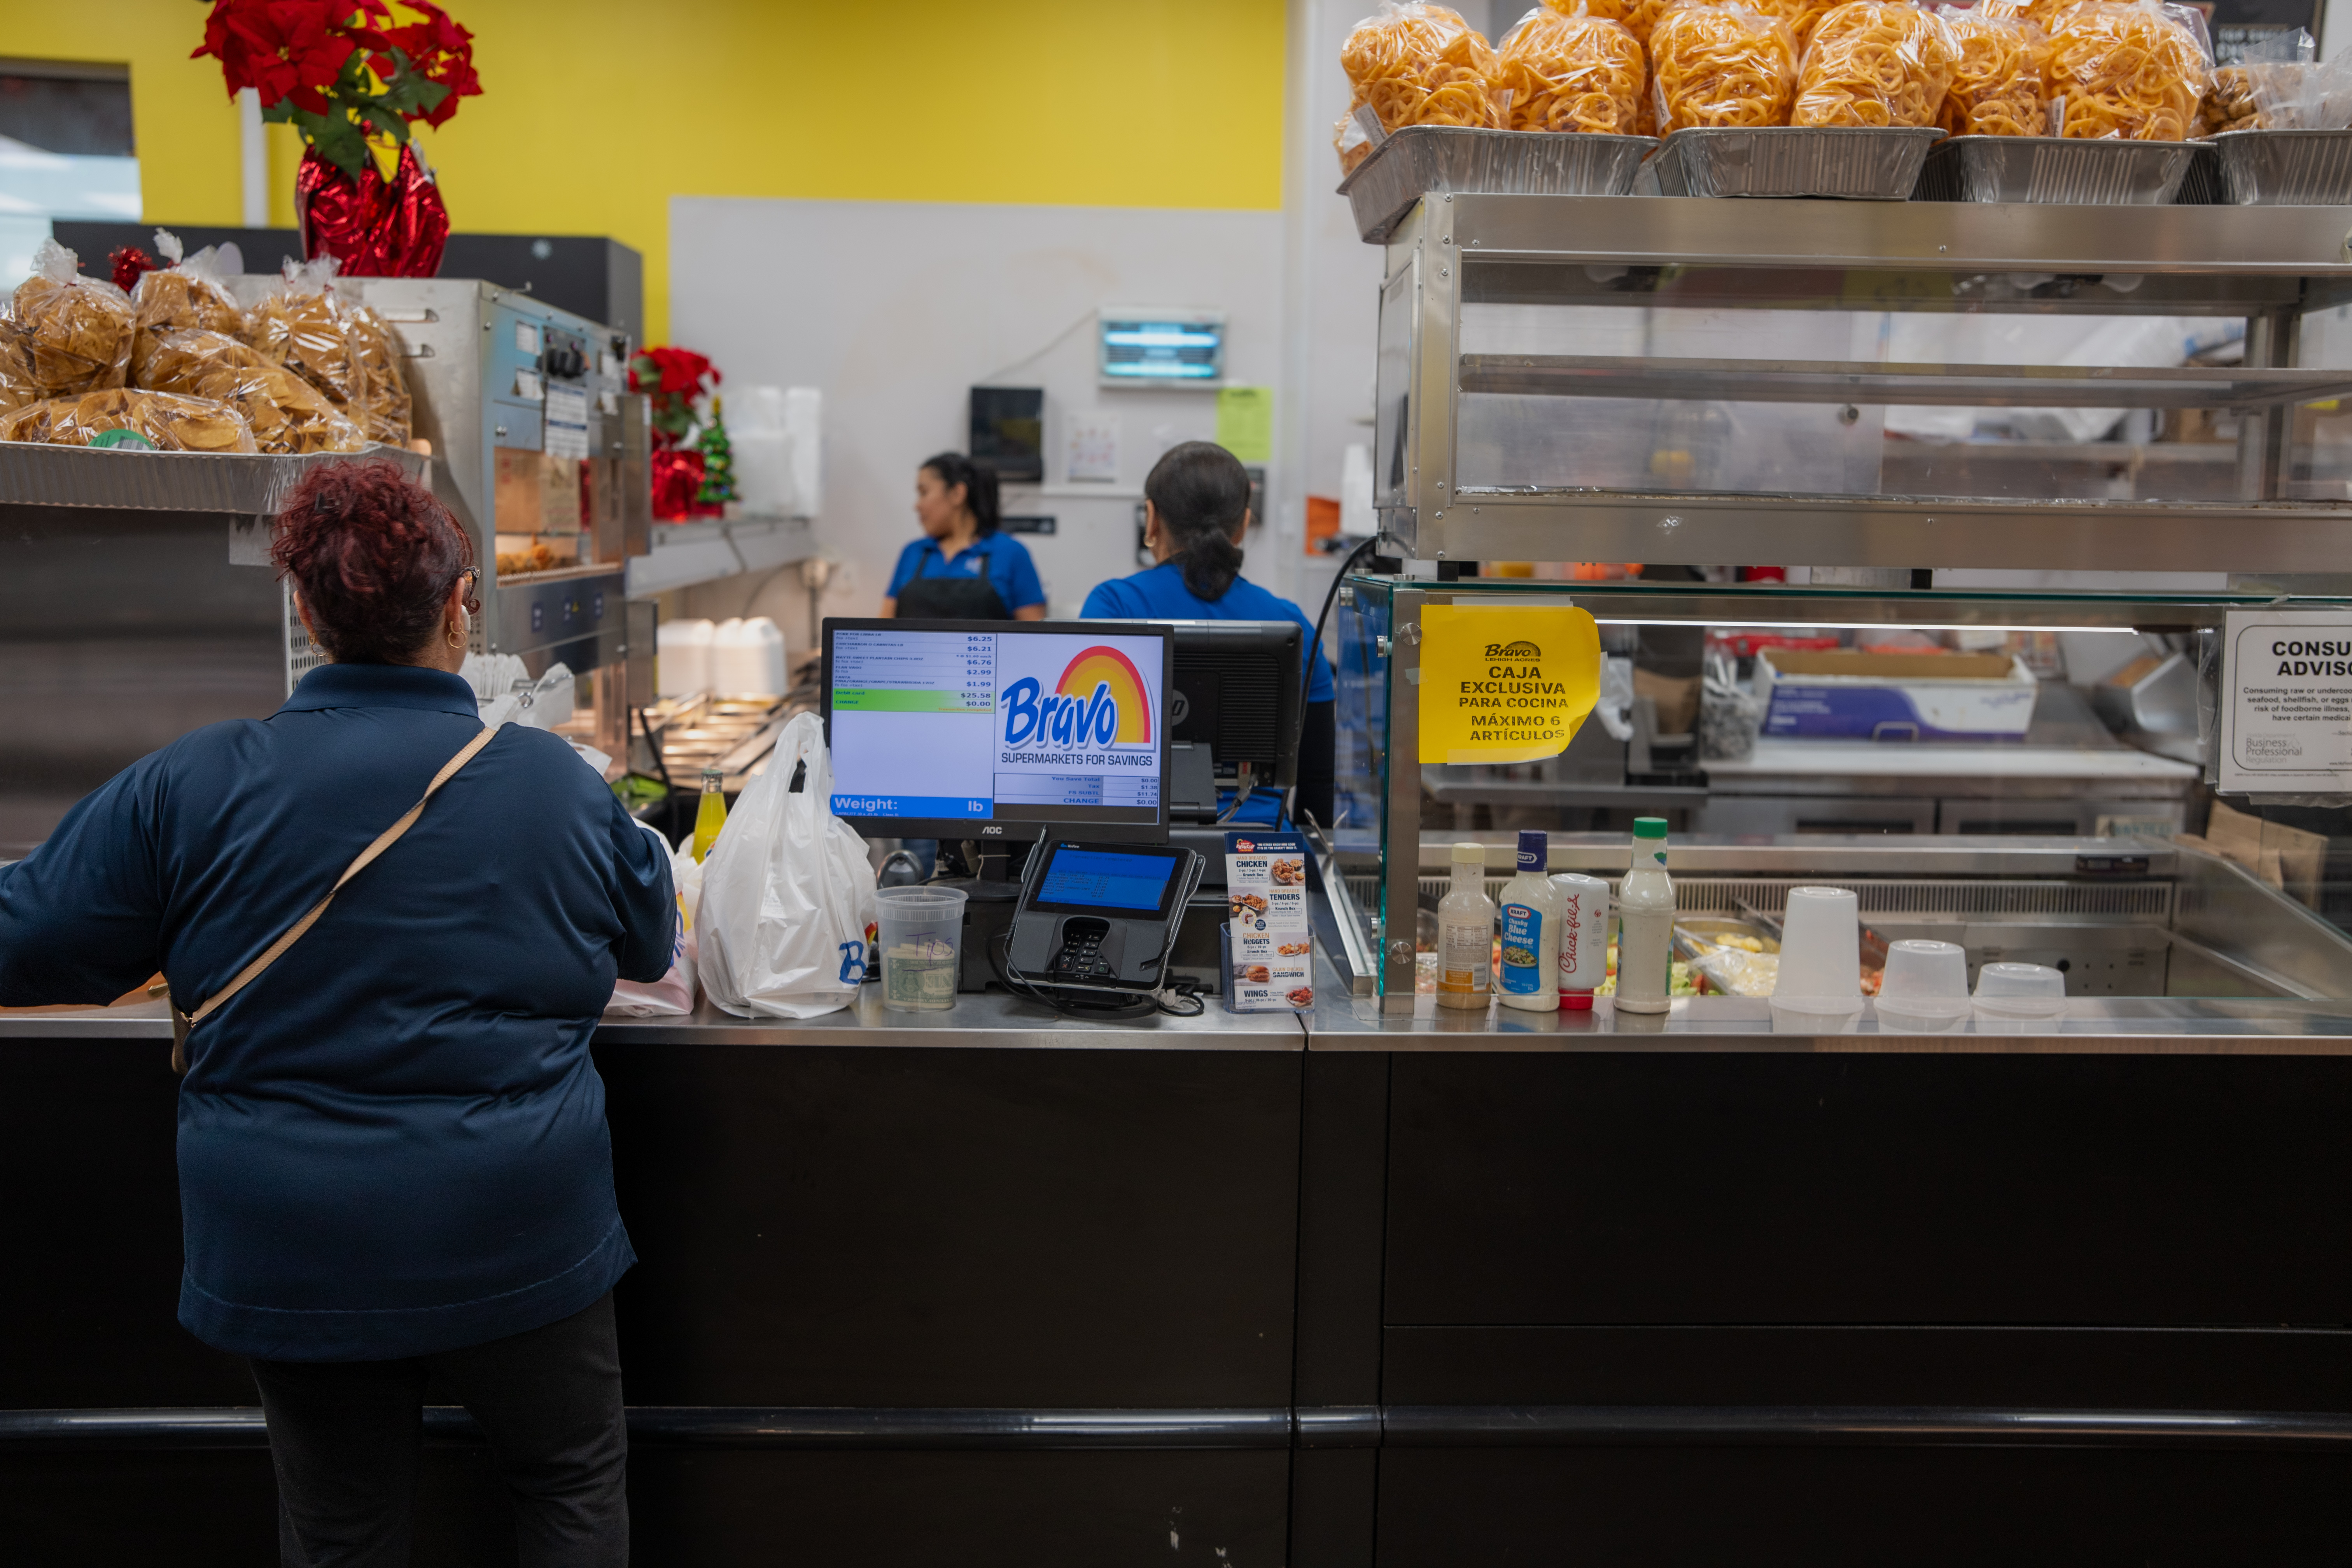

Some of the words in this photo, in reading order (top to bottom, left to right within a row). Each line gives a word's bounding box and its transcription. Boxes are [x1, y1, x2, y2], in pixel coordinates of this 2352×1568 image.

[1485, 644, 1531, 657] Bravo
[1489, 666, 1542, 679] CAJA
[1461, 682, 1566, 695] EXCLUSIVA
[2243, 687, 2288, 695] Consuming
[1459, 697, 1502, 708] PARA
[1507, 698, 1568, 708] COCINA
[1001, 677, 1115, 745] Bravo
[1472, 713, 1545, 726] MÁXIMO
[1550, 716, 1560, 726] 6
[1470, 728, 1564, 741] ARTÍCULOS
[2246, 738, 2287, 747] Business
[2246, 746, 2303, 756] Professional
[1001, 752, 1083, 764] SUPERMARKETS
[1086, 754, 1105, 765] FOR
[1108, 755, 1152, 766] SAVINGS
[835, 798, 898, 812] Weight:
[968, 800, 983, 812] lb
[982, 826, 1002, 835] AOC
[1508, 918, 1528, 928] Chunky
[1508, 924, 1527, 935] Blue
[1504, 932, 1534, 945] Cheese
[1558, 894, 1580, 973] Chick-fil-A
[906, 932, 953, 966] Tips
